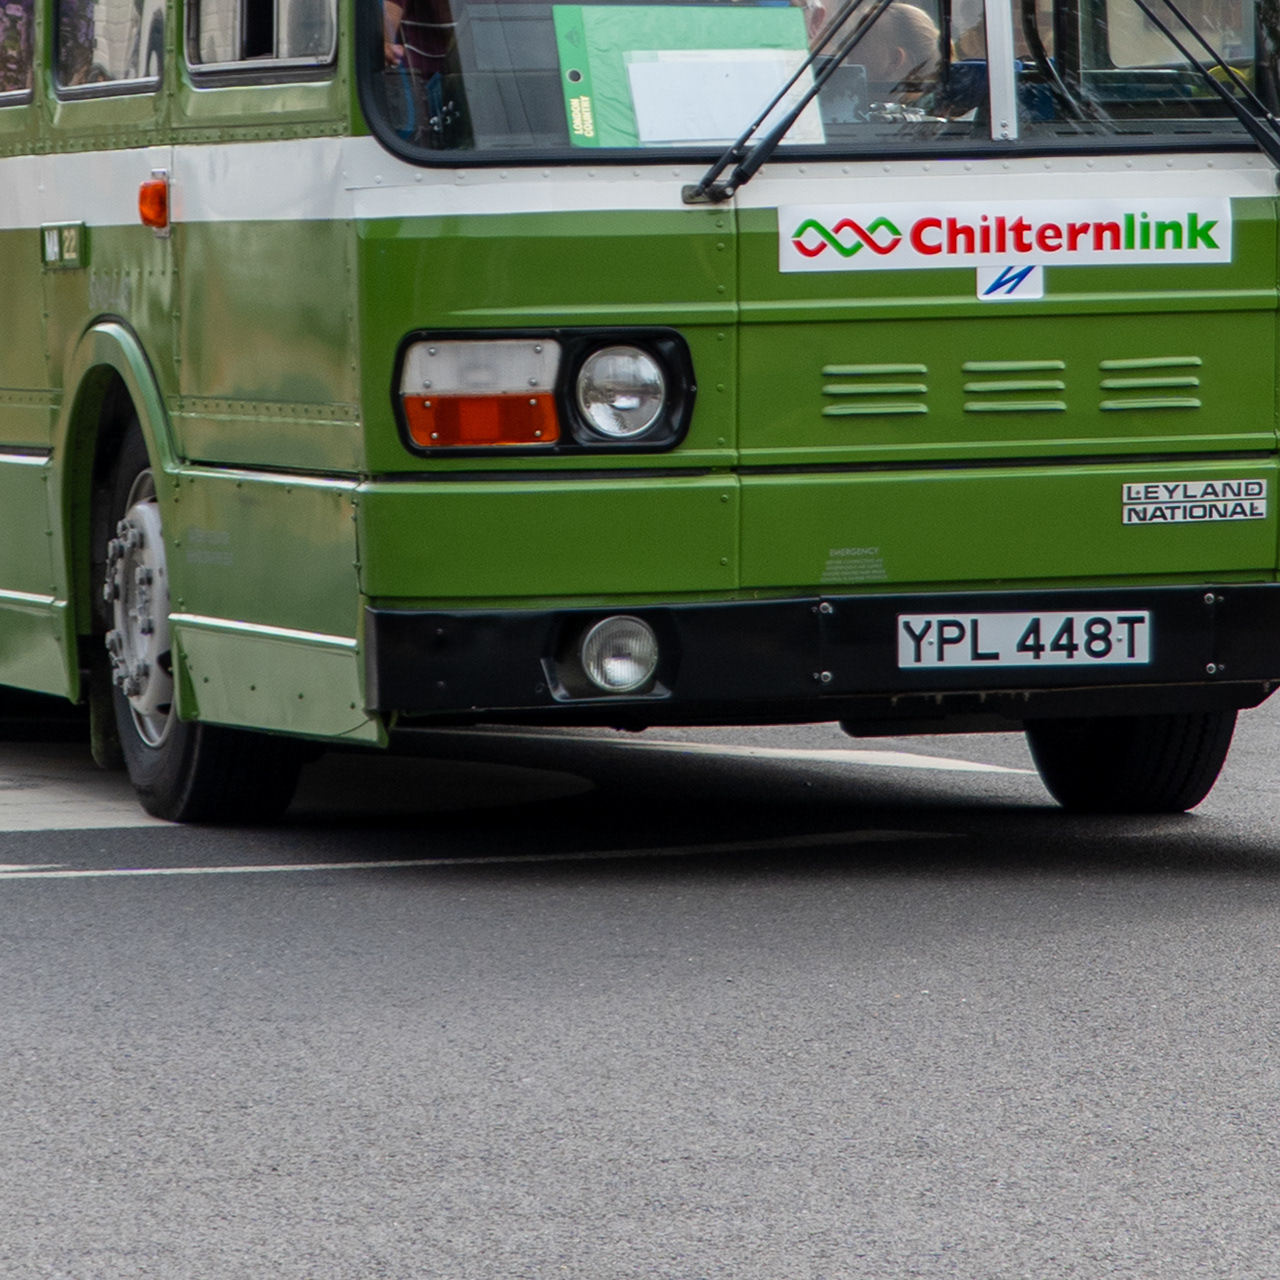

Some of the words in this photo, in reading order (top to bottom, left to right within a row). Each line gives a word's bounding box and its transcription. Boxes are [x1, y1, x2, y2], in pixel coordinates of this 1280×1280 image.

[570, 98, 584, 134] LONDON
[580, 95, 594, 137] COUNTRY
[63, 229, 77, 259] 22
[910, 211, 1220, 255] Chilternlink
[1126, 481, 1263, 500] LEYLAND
[1127, 502, 1264, 522] NATIONAL
[829, 547, 879, 557] EMERGENCY
[902, 618, 1000, 663] YPL
[1016, 616, 1146, 660] 448T
